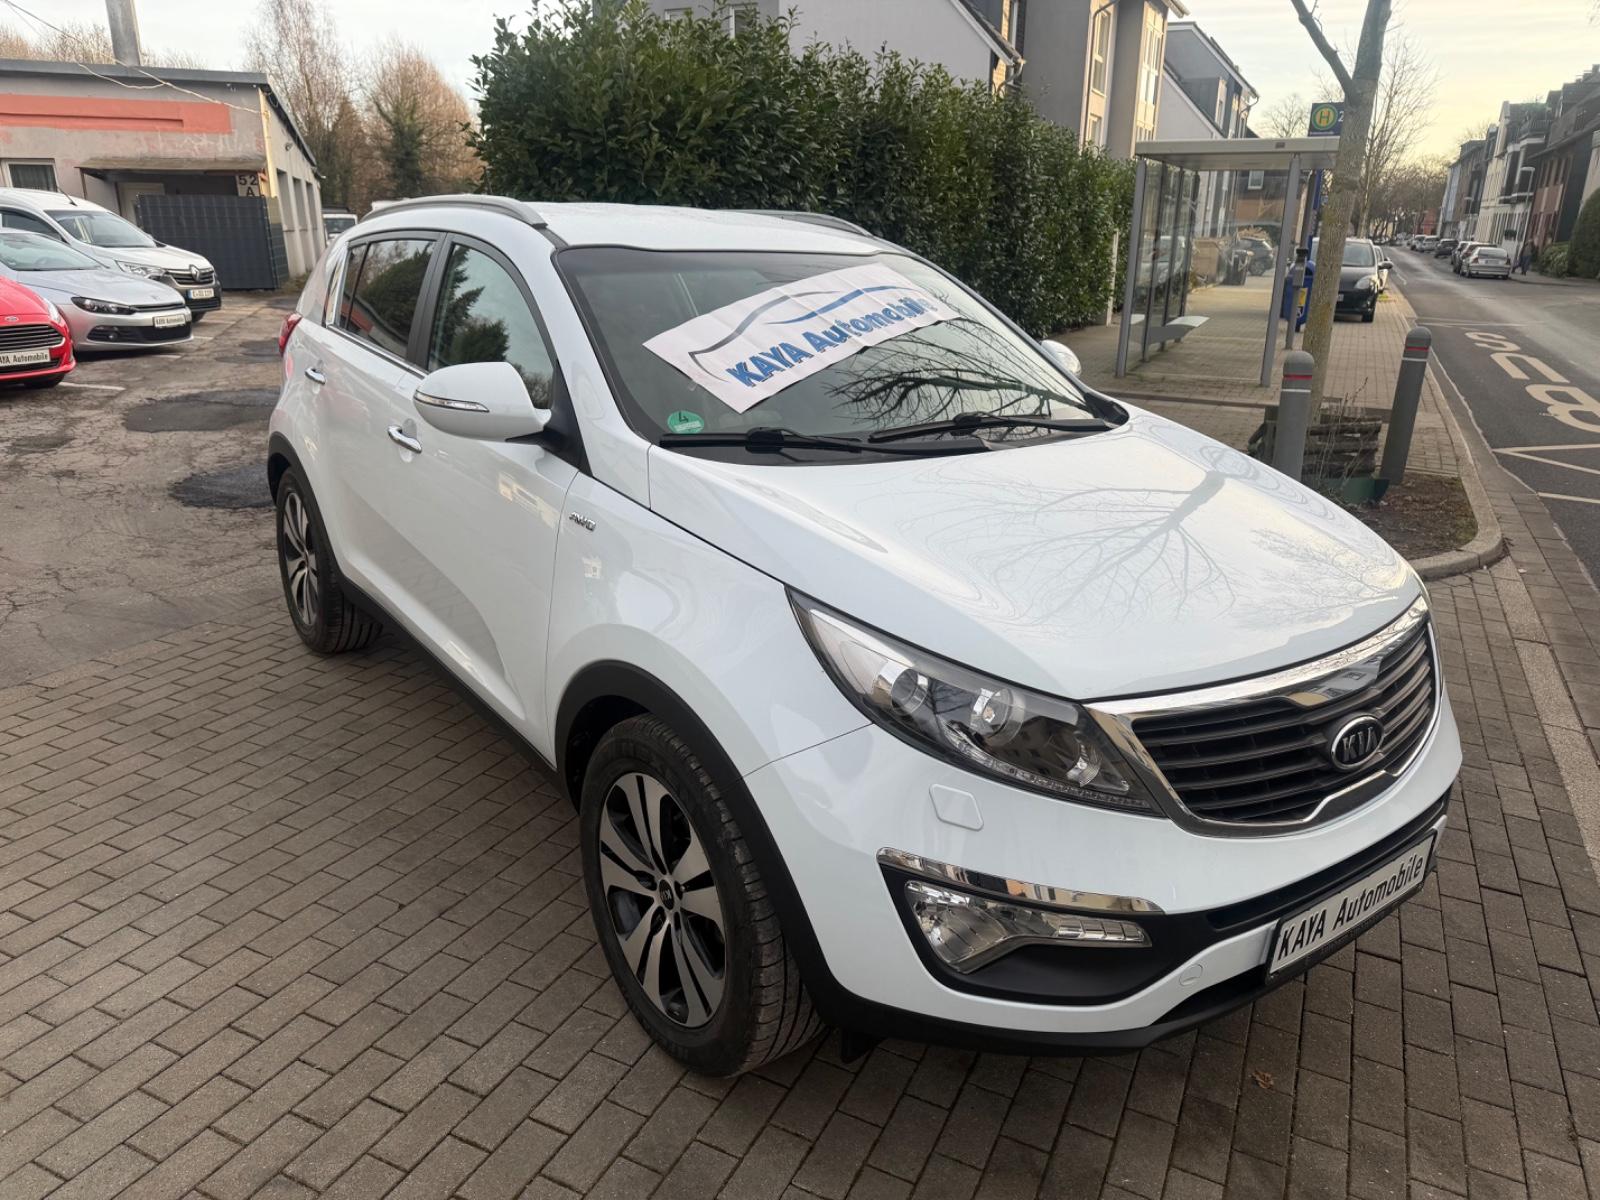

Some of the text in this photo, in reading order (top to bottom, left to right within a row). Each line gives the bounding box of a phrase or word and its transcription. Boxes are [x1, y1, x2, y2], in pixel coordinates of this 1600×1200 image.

[238, 175, 258, 186] 52
[246, 186, 255, 197] A
[13, 352, 49, 363] Automobile
[725, 342, 815, 388] KAYA
[1465, 331, 1600, 434] BUS
[1277, 854, 1424, 961] KAYA Automobile
